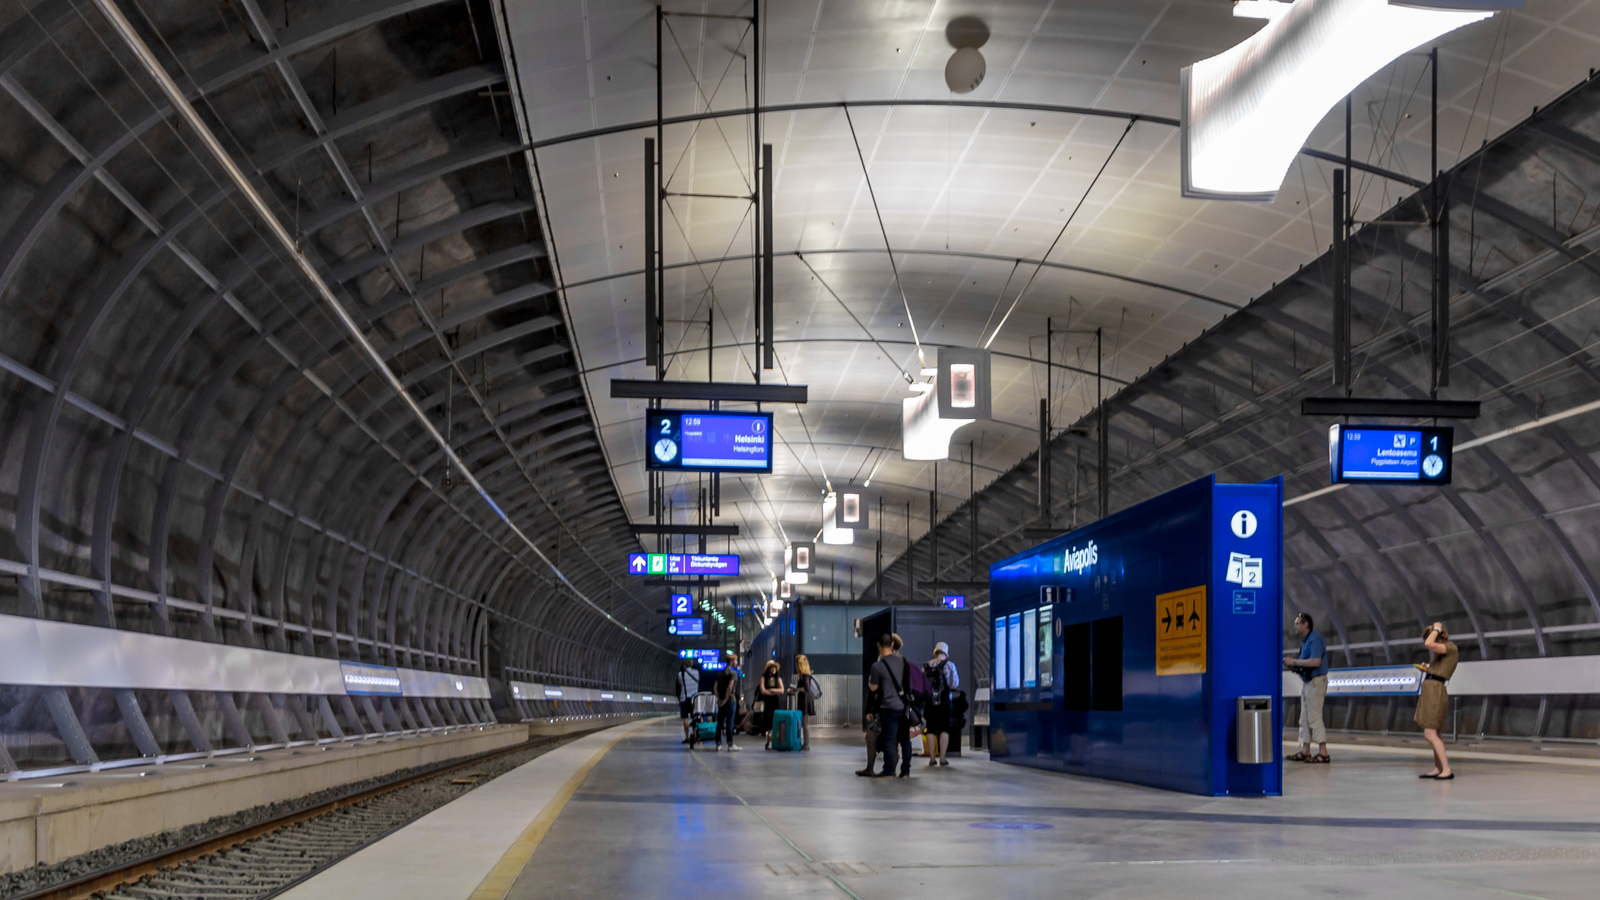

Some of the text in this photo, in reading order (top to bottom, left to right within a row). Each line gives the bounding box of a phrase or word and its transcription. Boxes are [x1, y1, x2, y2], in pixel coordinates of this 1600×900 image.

[661, 419, 671, 434] 2
[735, 435, 765, 444] Helsinki
[1430, 435, 1438, 451] 1
[734, 445, 764, 454] Helsingfors
[1377, 448, 1417, 457] Lentoasema
[1064, 540, 1098, 575] Aviapolis
[1249, 572, 1256, 583] 2
[677, 597, 687, 612] 2
[950, 598, 957, 609] 1
